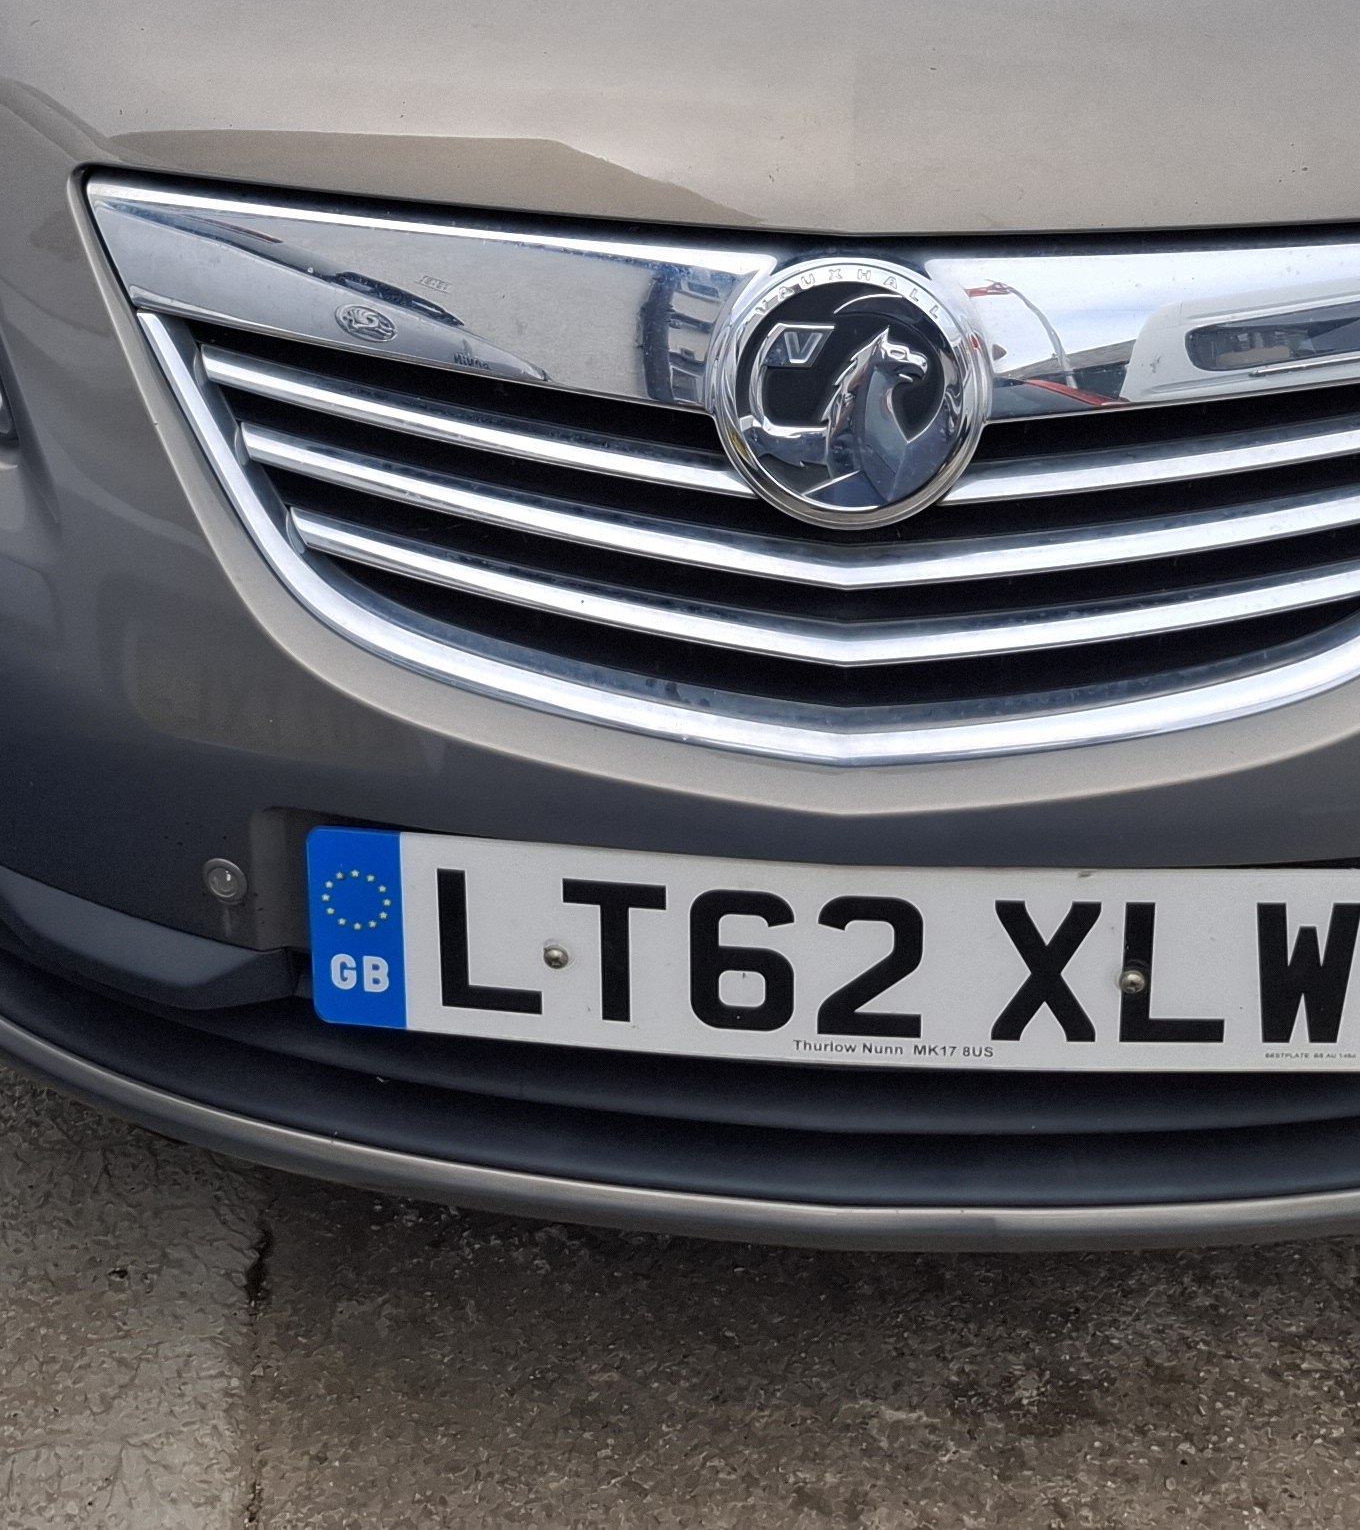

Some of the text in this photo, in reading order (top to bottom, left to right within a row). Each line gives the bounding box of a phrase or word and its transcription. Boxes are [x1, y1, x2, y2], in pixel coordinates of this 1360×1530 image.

[755, 268, 941, 321] VAUXHALL
[330, 953, 390, 993] GB
[437, 868, 924, 1039] LT62
[793, 1039, 995, 1058] Thurlow Nunn MK17 8US
